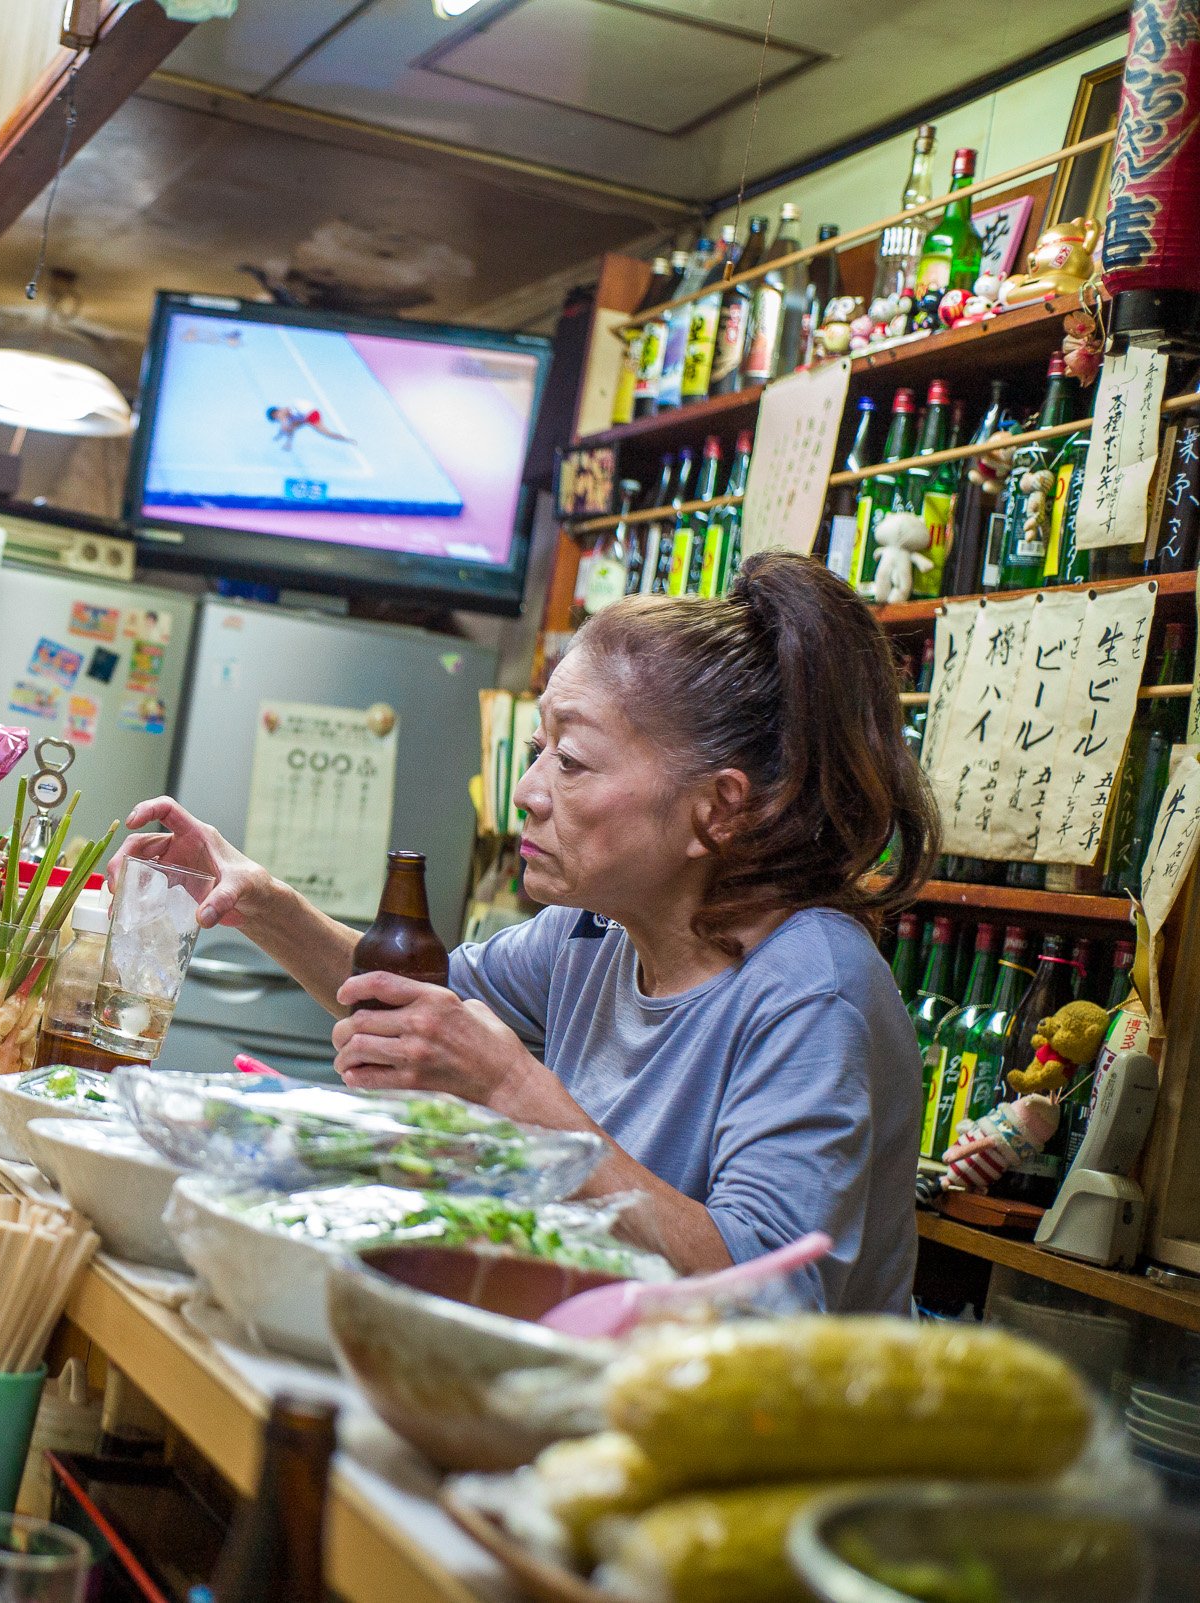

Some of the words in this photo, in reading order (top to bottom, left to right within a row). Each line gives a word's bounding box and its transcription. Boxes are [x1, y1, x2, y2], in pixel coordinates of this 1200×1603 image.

[964, 620, 1016, 743] 樽ハイ
[1013, 638, 1068, 752] ビール
[1073, 621, 1125, 757] 生ビール
[1131, 616, 1158, 661] アサヒ
[1119, 1017, 1144, 1051] 博多
